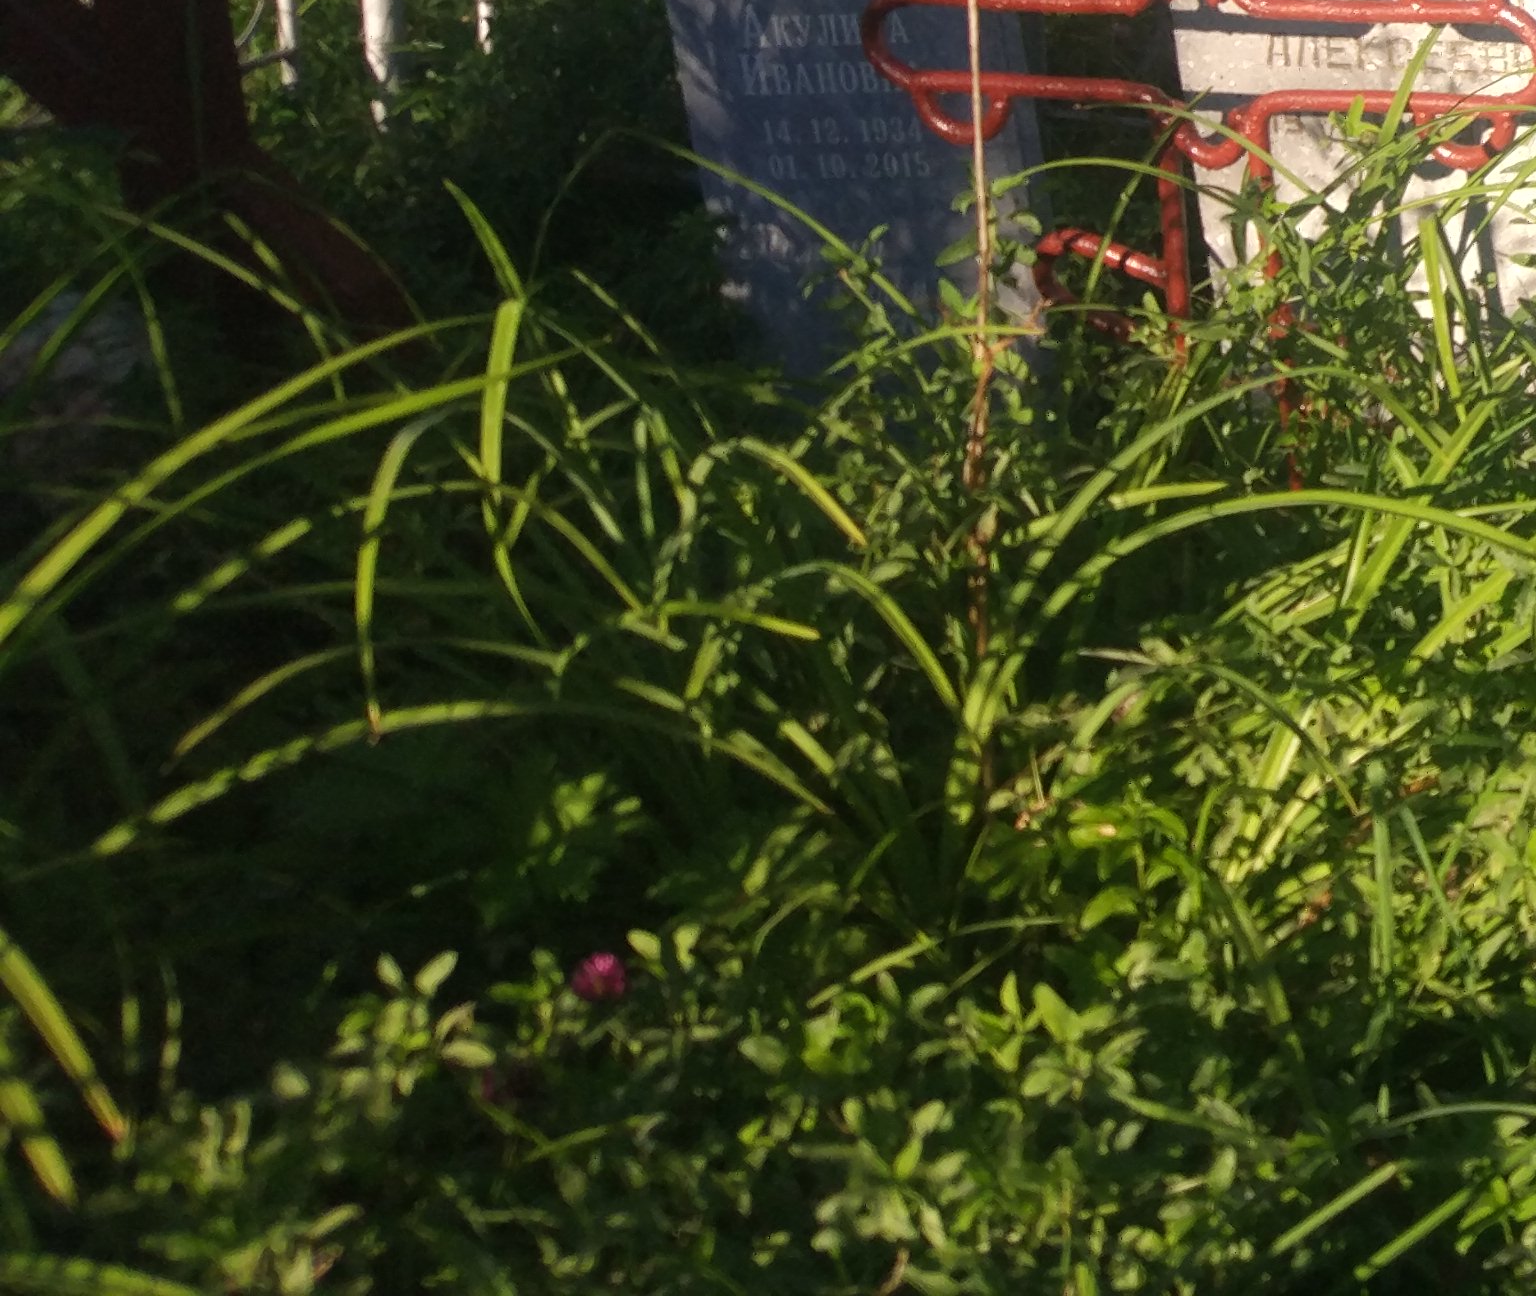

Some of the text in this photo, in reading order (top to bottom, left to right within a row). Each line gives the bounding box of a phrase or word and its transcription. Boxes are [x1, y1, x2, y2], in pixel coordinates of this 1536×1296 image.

[744, 4, 910, 48] АКУЛИА
[740, 54, 905, 96] ИВАНОВ
[863, 151, 931, 178] 2015
